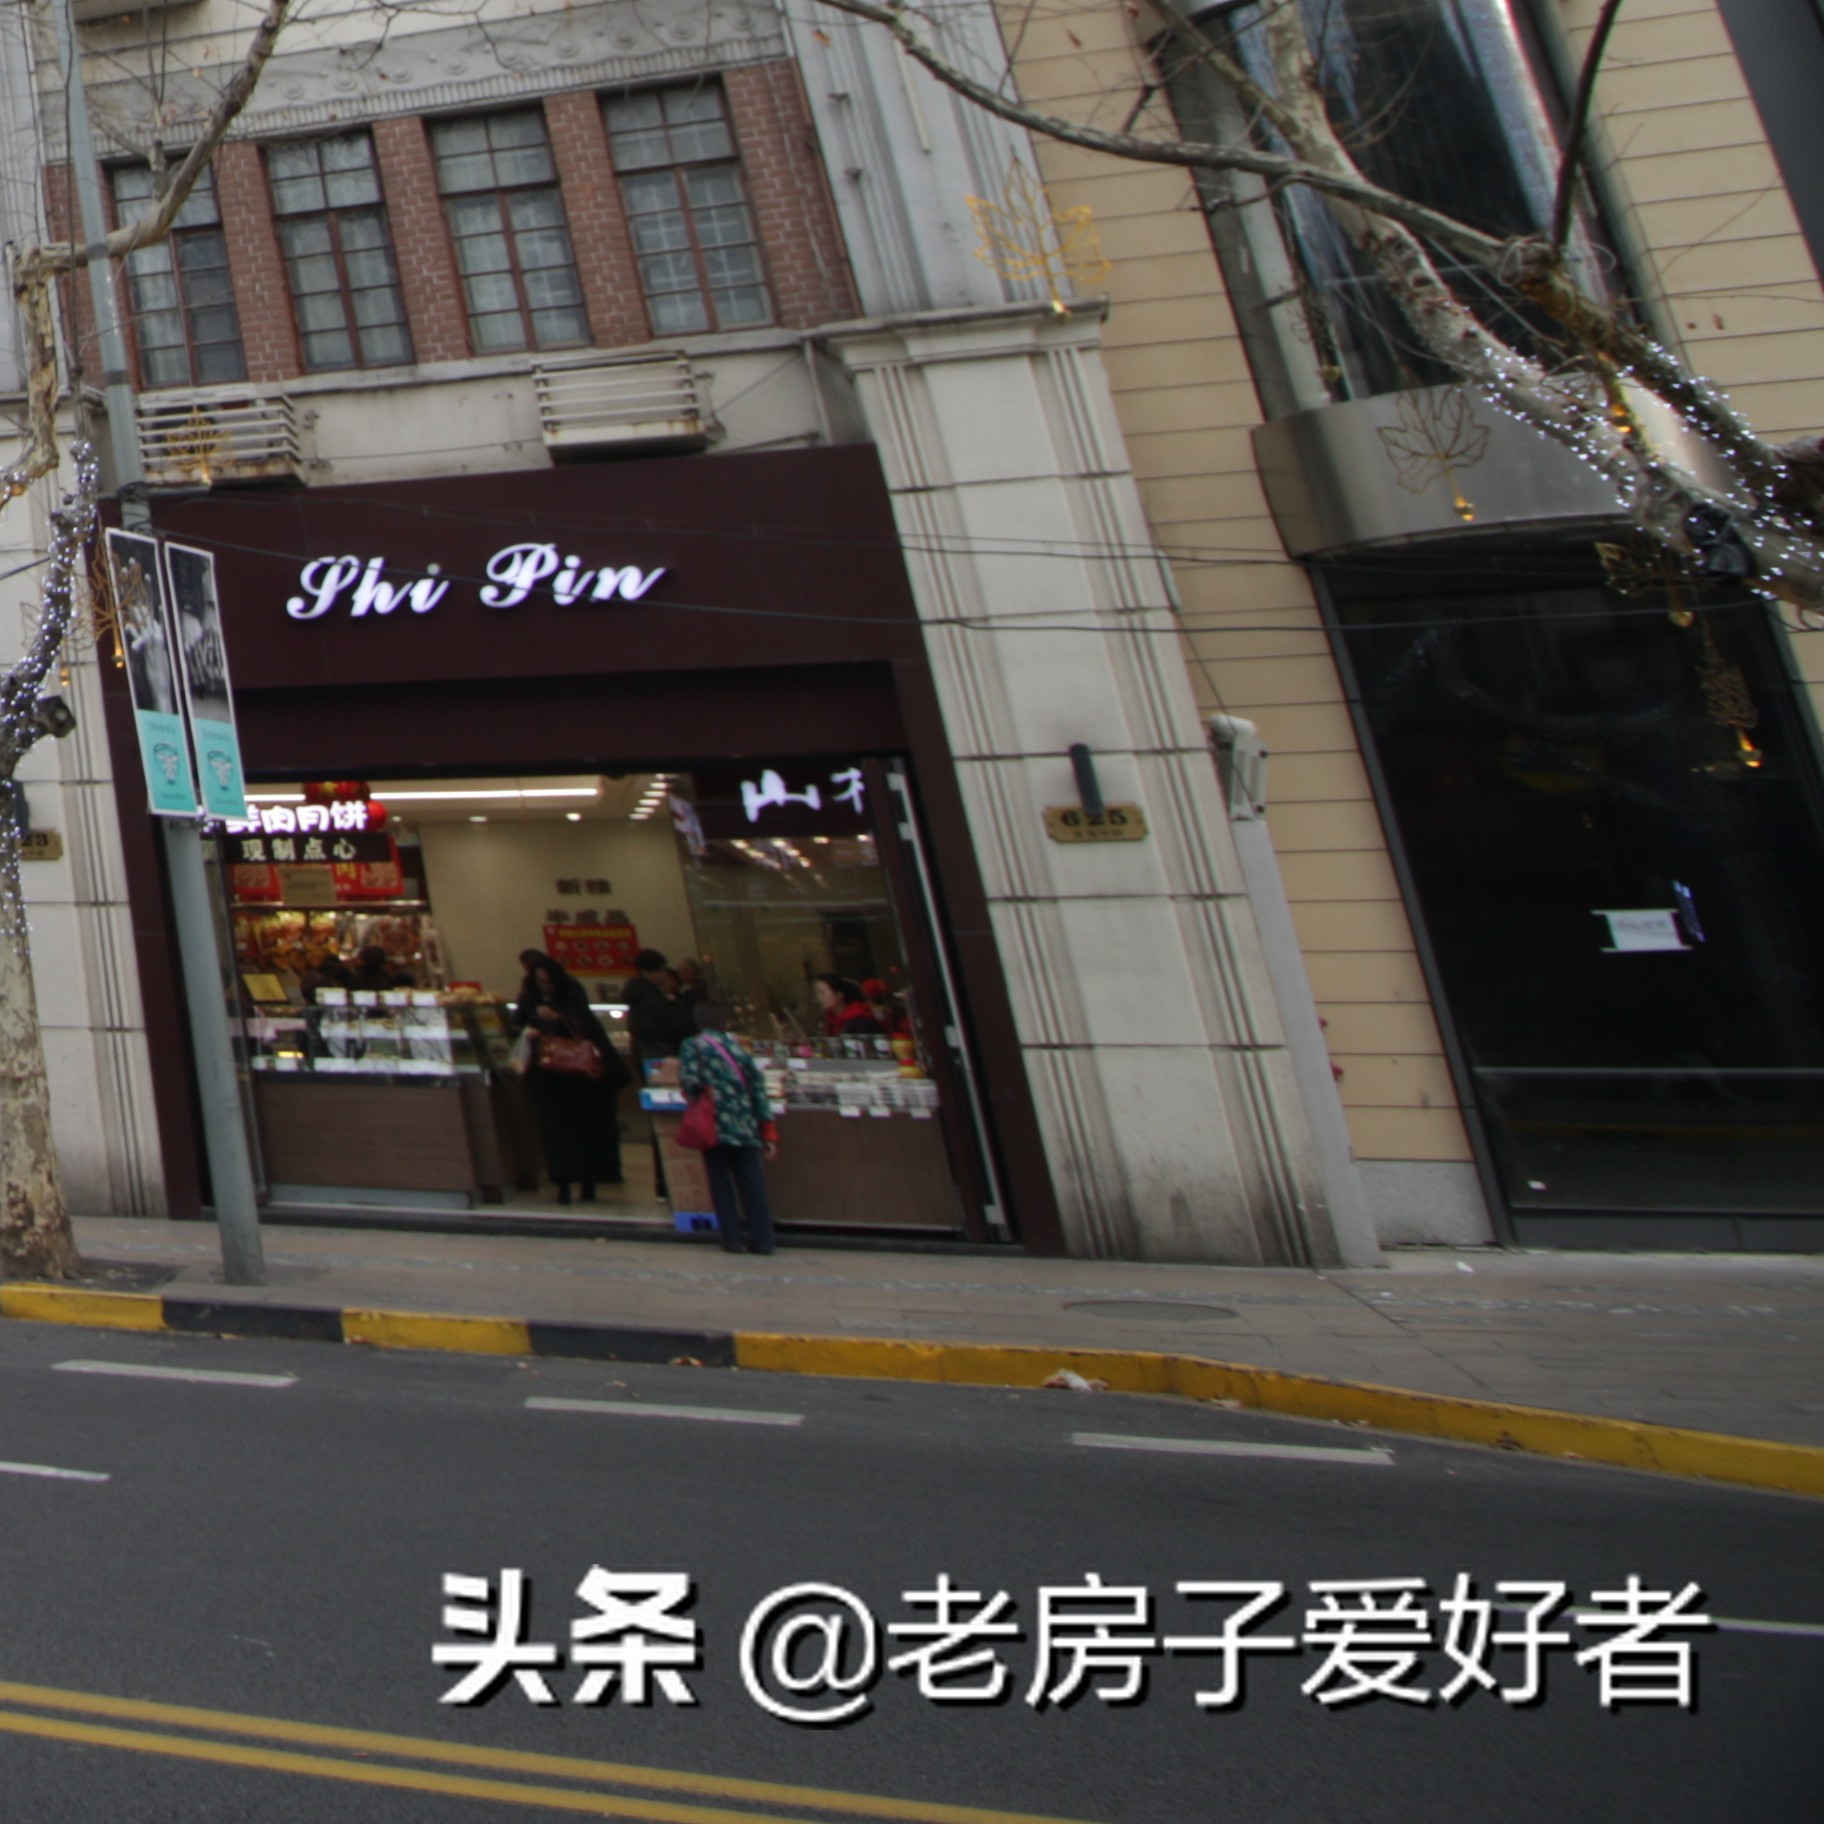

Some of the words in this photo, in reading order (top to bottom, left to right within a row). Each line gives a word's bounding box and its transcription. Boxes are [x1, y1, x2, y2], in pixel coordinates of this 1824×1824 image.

[285, 554, 450, 619] Shi
[479, 542, 666, 608] Pin
[20, 831, 49, 847] 23
[241, 837, 356, 862] 现制点心
